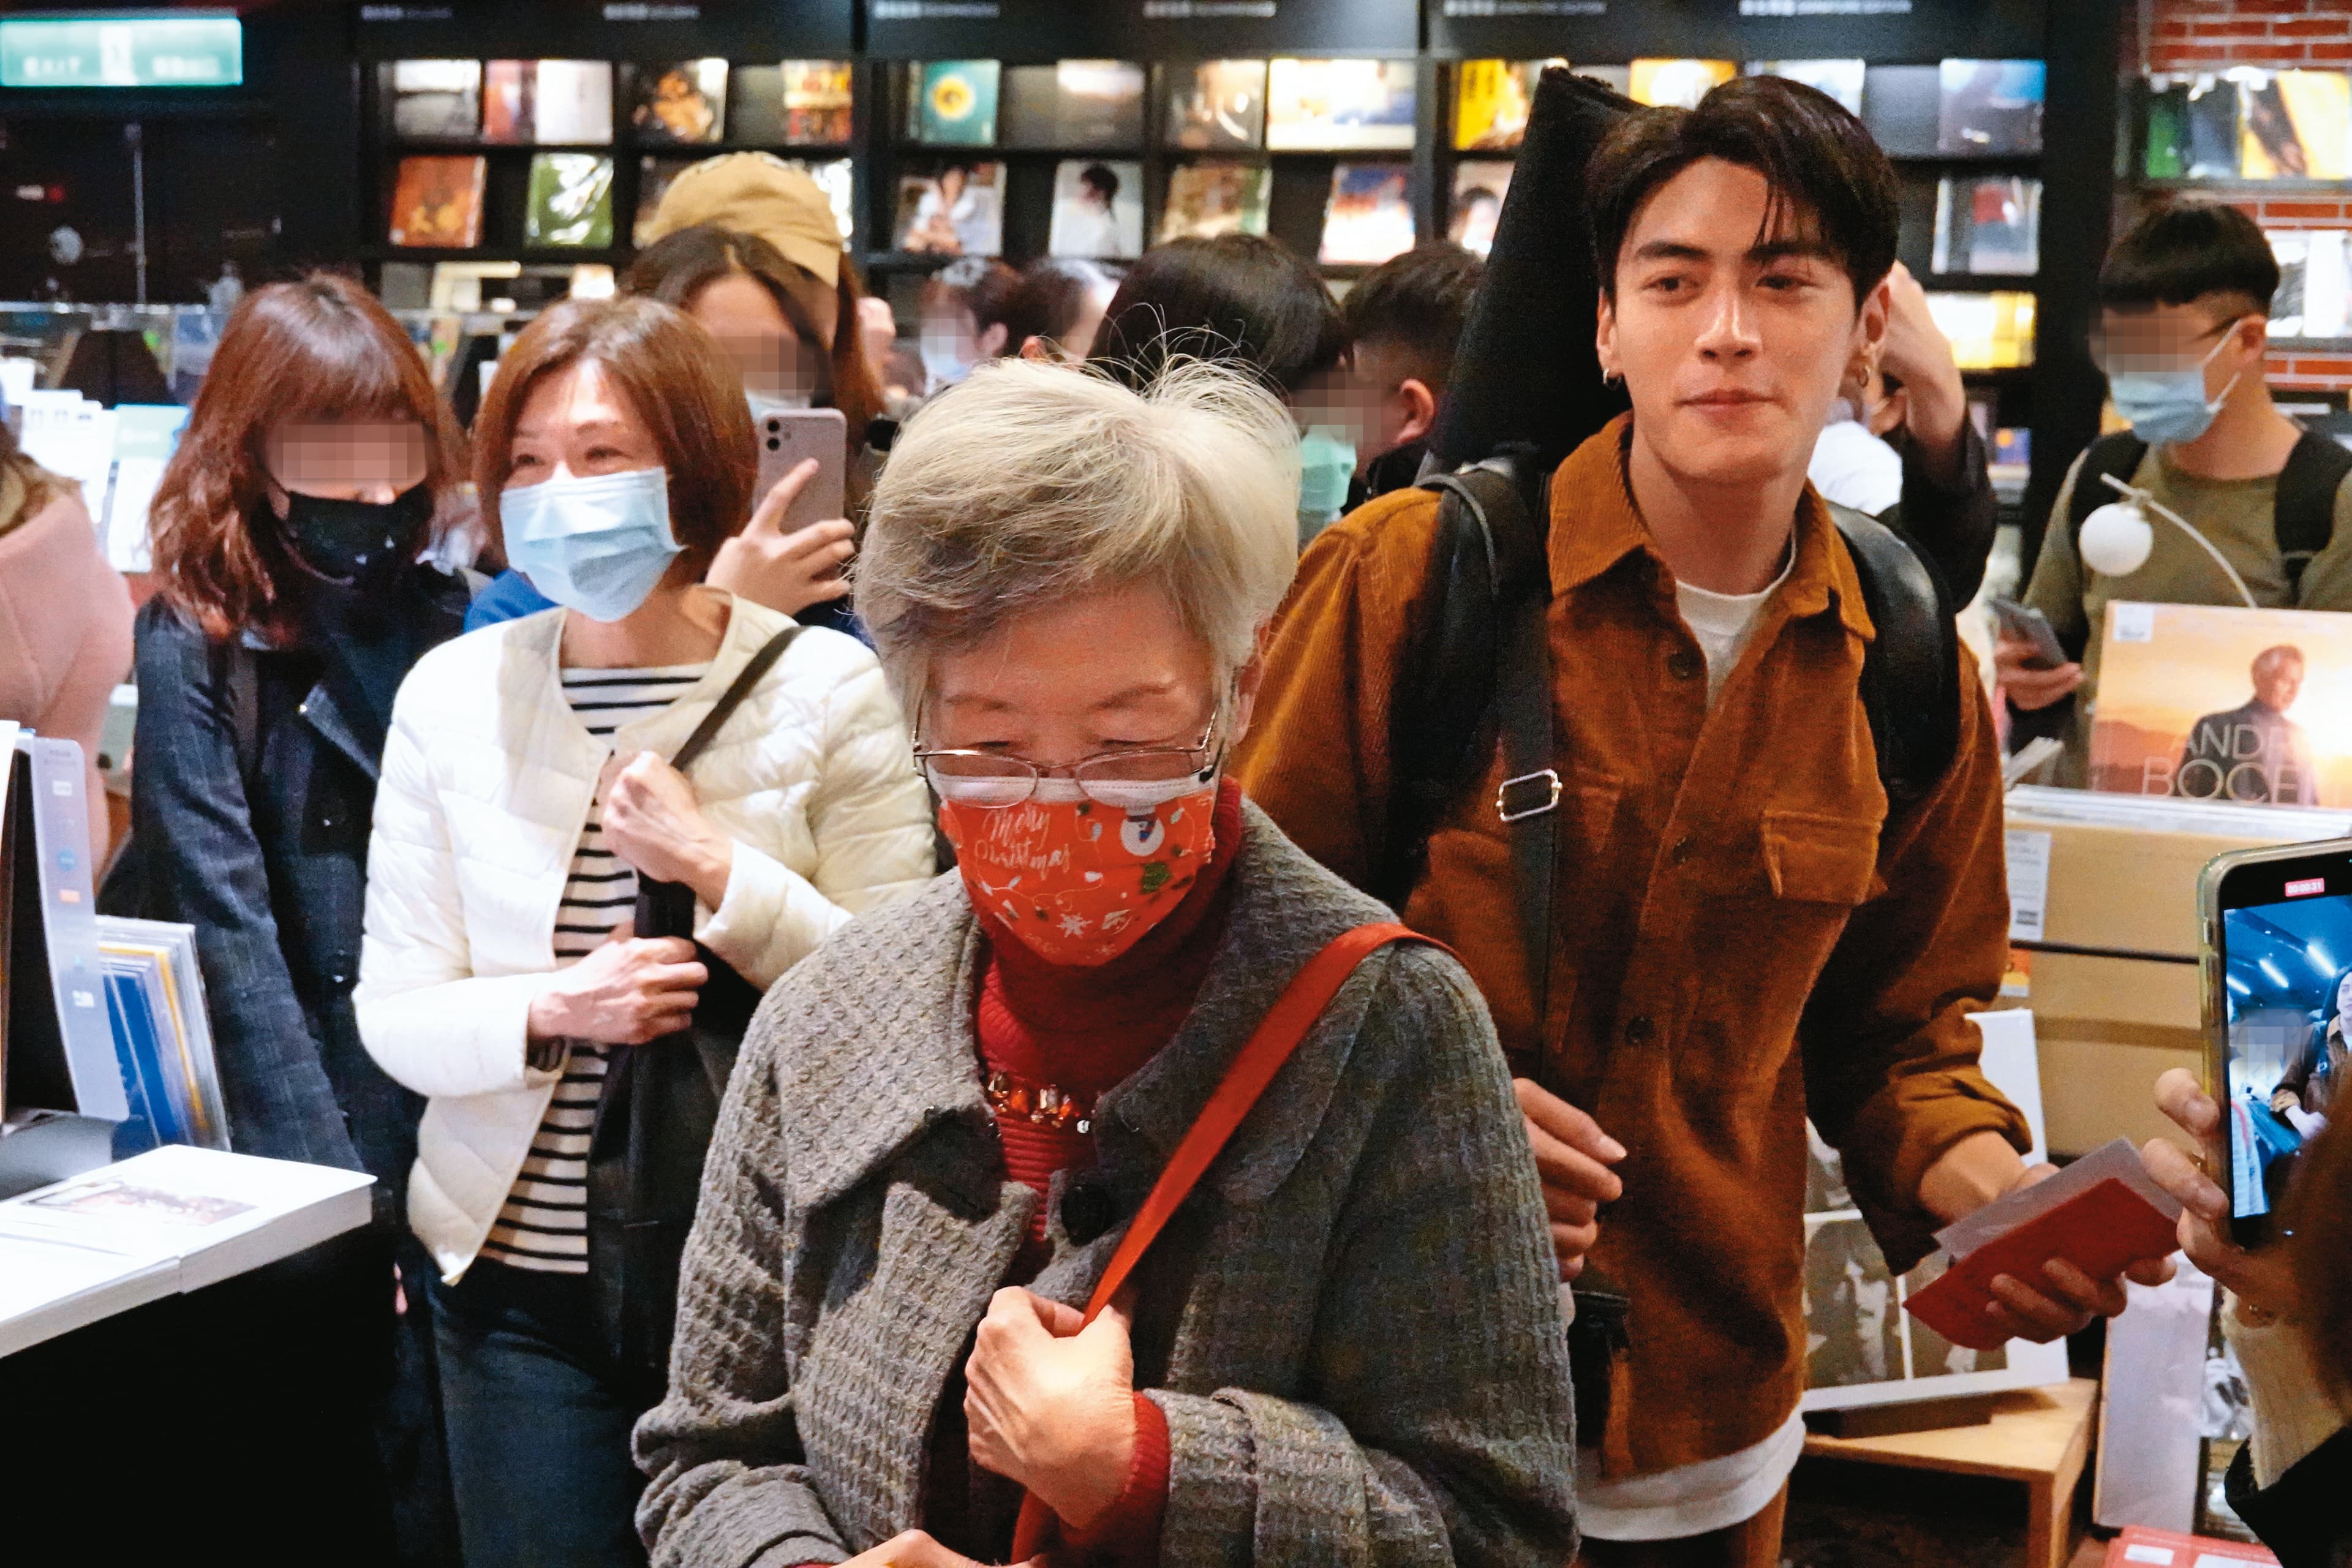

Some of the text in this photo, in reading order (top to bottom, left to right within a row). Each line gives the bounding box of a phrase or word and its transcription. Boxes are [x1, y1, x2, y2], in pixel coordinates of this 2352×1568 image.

[982, 803, 1050, 852] Merry
[974, 837, 1070, 881] Christmas
[2287, 881, 2321, 894] 00:00:31
